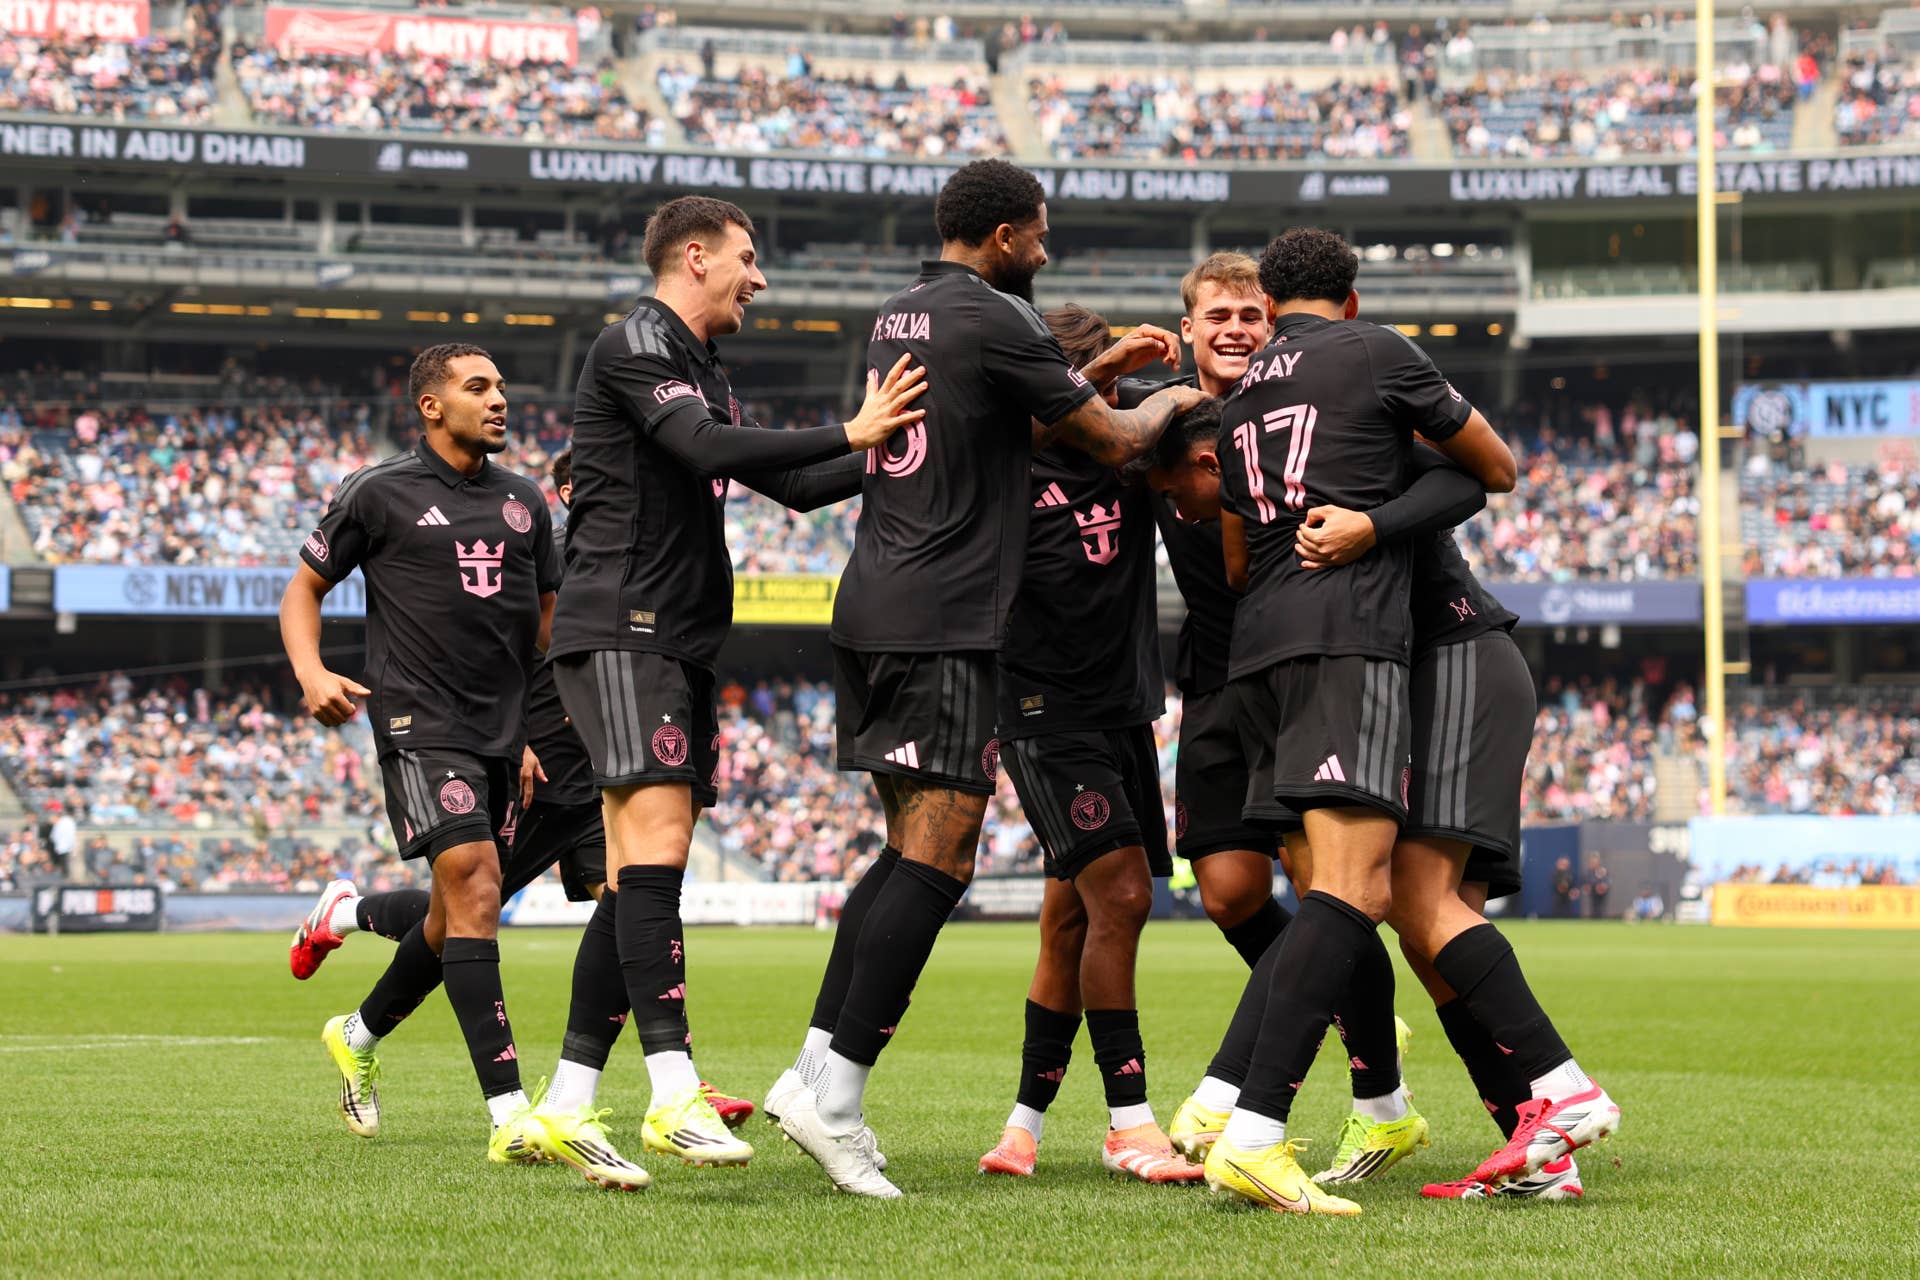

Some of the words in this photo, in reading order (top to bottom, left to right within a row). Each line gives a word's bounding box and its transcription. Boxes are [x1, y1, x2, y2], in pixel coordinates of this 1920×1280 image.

[394, 21, 488, 56] PARTY
[489, 24, 570, 64] DECK
[80, 129, 117, 160] IN
[122, 131, 195, 163] ABU
[202, 135, 306, 168] DHABI
[529, 149, 658, 182] LUXURY
[663, 155, 746, 188] REAL
[749, 158, 865, 194] ESTATE
[870, 164, 957, 197] PART
[1060, 170, 1126, 200] ABU
[1132, 171, 1229, 202] DHABI
[1449, 169, 1580, 200] LUXURY
[1586, 166, 1671, 197] REAL
[1677, 160, 1801, 196] ETATE
[1825, 390, 1889, 428] NYC
[1233, 403, 1318, 525] 17
[165, 573, 227, 607] NEW
